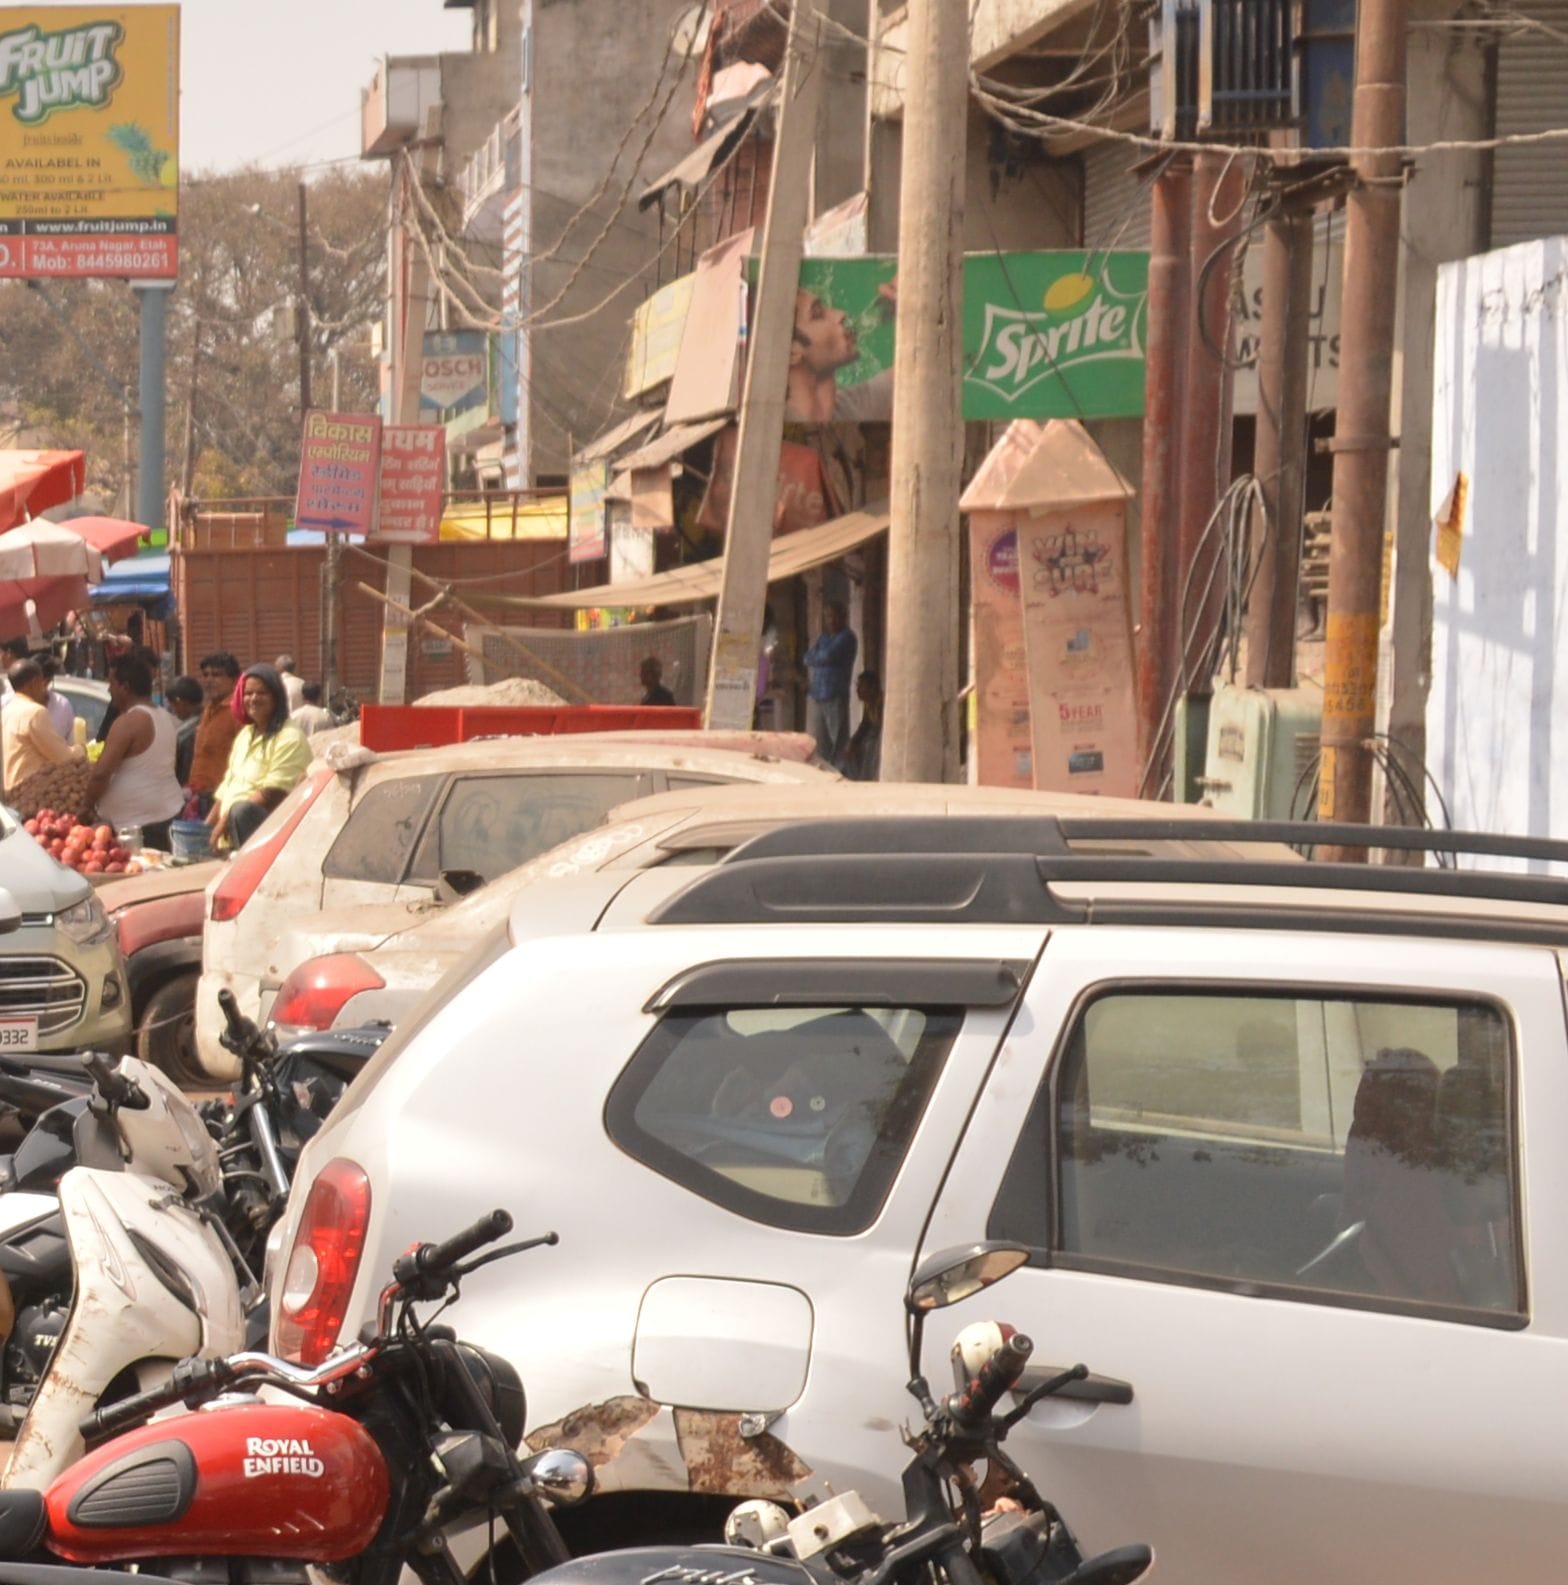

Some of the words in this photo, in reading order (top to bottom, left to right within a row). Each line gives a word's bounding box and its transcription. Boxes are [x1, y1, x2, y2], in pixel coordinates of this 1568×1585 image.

[18, 60, 112, 118] JUMP
[87, 157, 101, 168] IN
[36, 219, 167, 234] www.fruitjump.in
[32, 256, 72, 270] Mob:
[986, 294, 1126, 384] Sprite
[424, 358, 482, 378] OSCH
[308, 413, 375, 443] विकास
[1071, 705, 1103, 718] YEAR
[246, 1437, 314, 1457] ROYAL
[243, 1457, 324, 1478] ENFIELD
